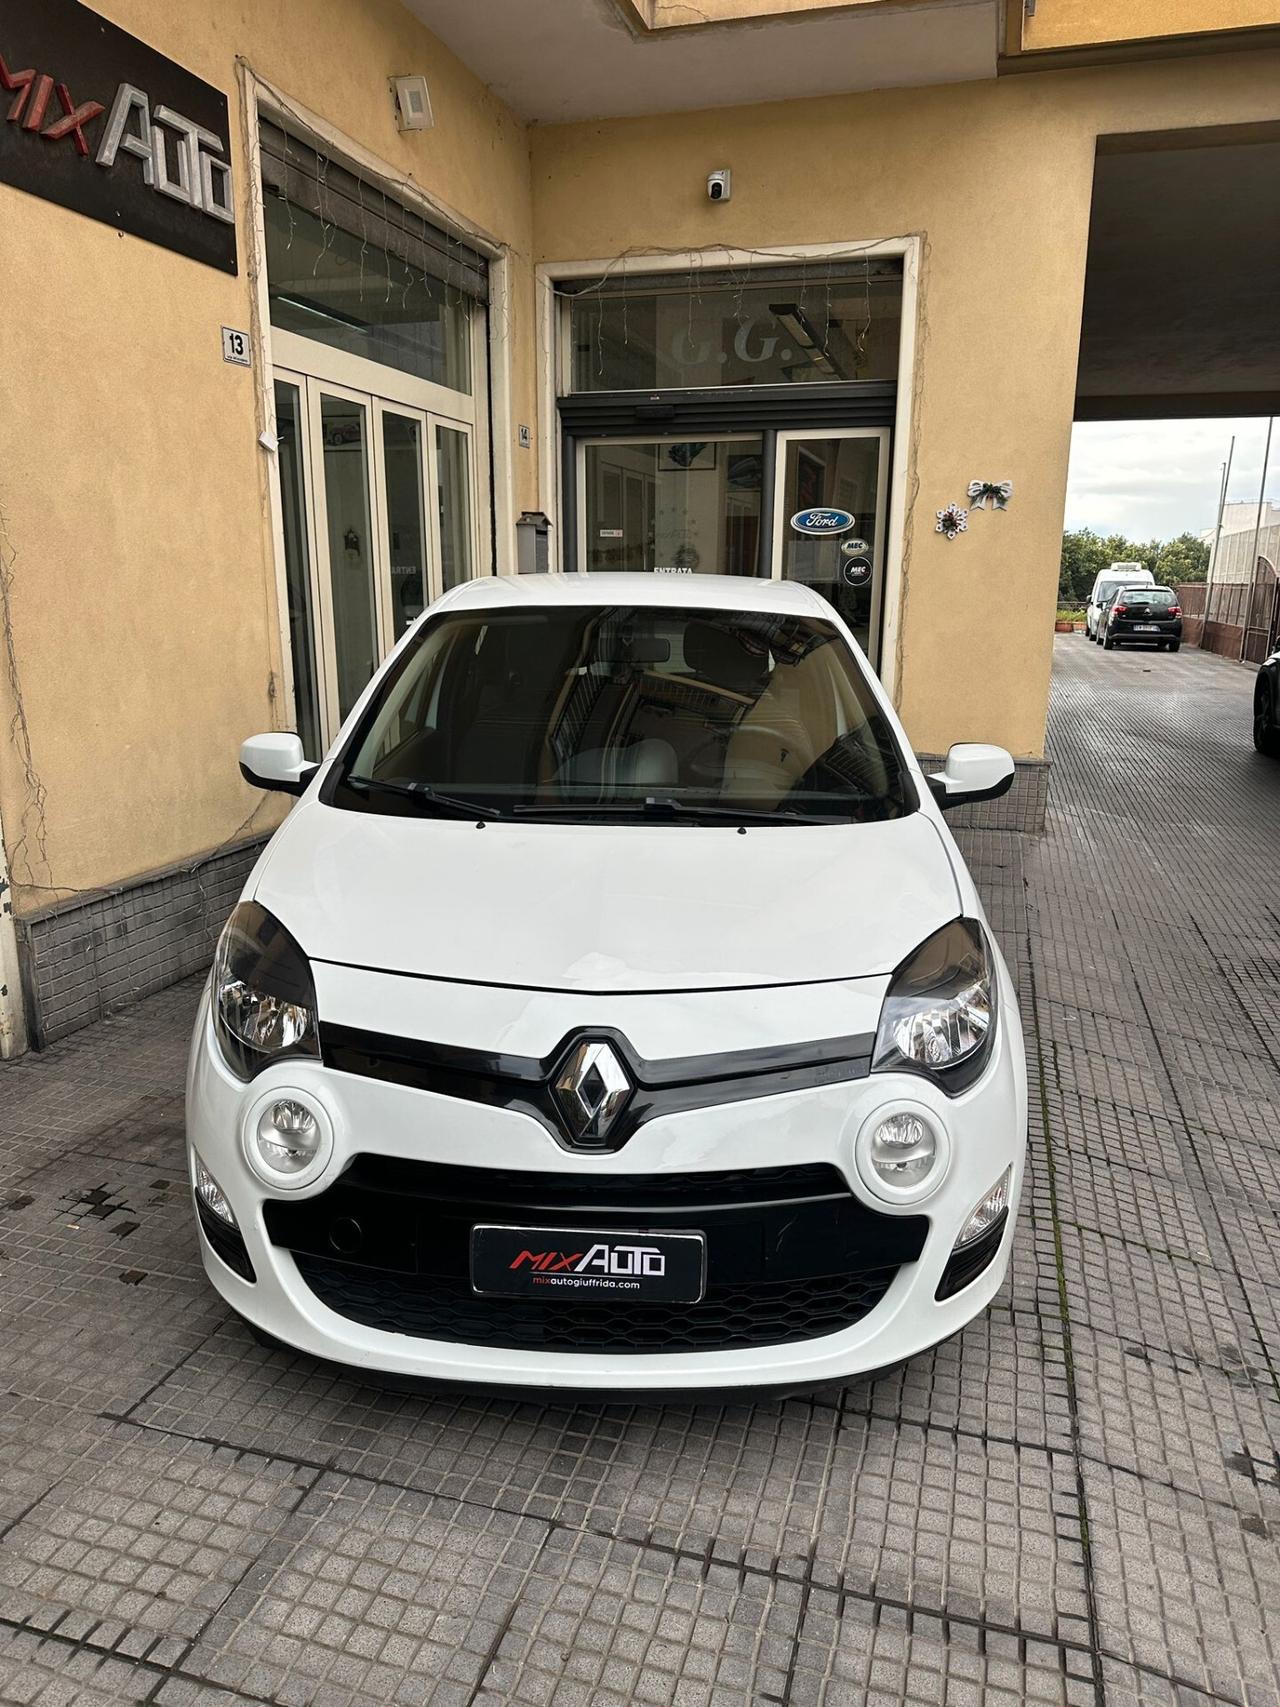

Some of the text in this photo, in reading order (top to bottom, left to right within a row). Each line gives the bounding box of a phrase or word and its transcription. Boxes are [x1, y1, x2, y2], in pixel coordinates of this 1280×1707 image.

[229, 333, 244, 355] 13
[805, 512, 839, 527] Ford
[653, 567, 693, 575] ENTRATA
[532, 1275, 640, 1289] mixautogiuffrida.com
